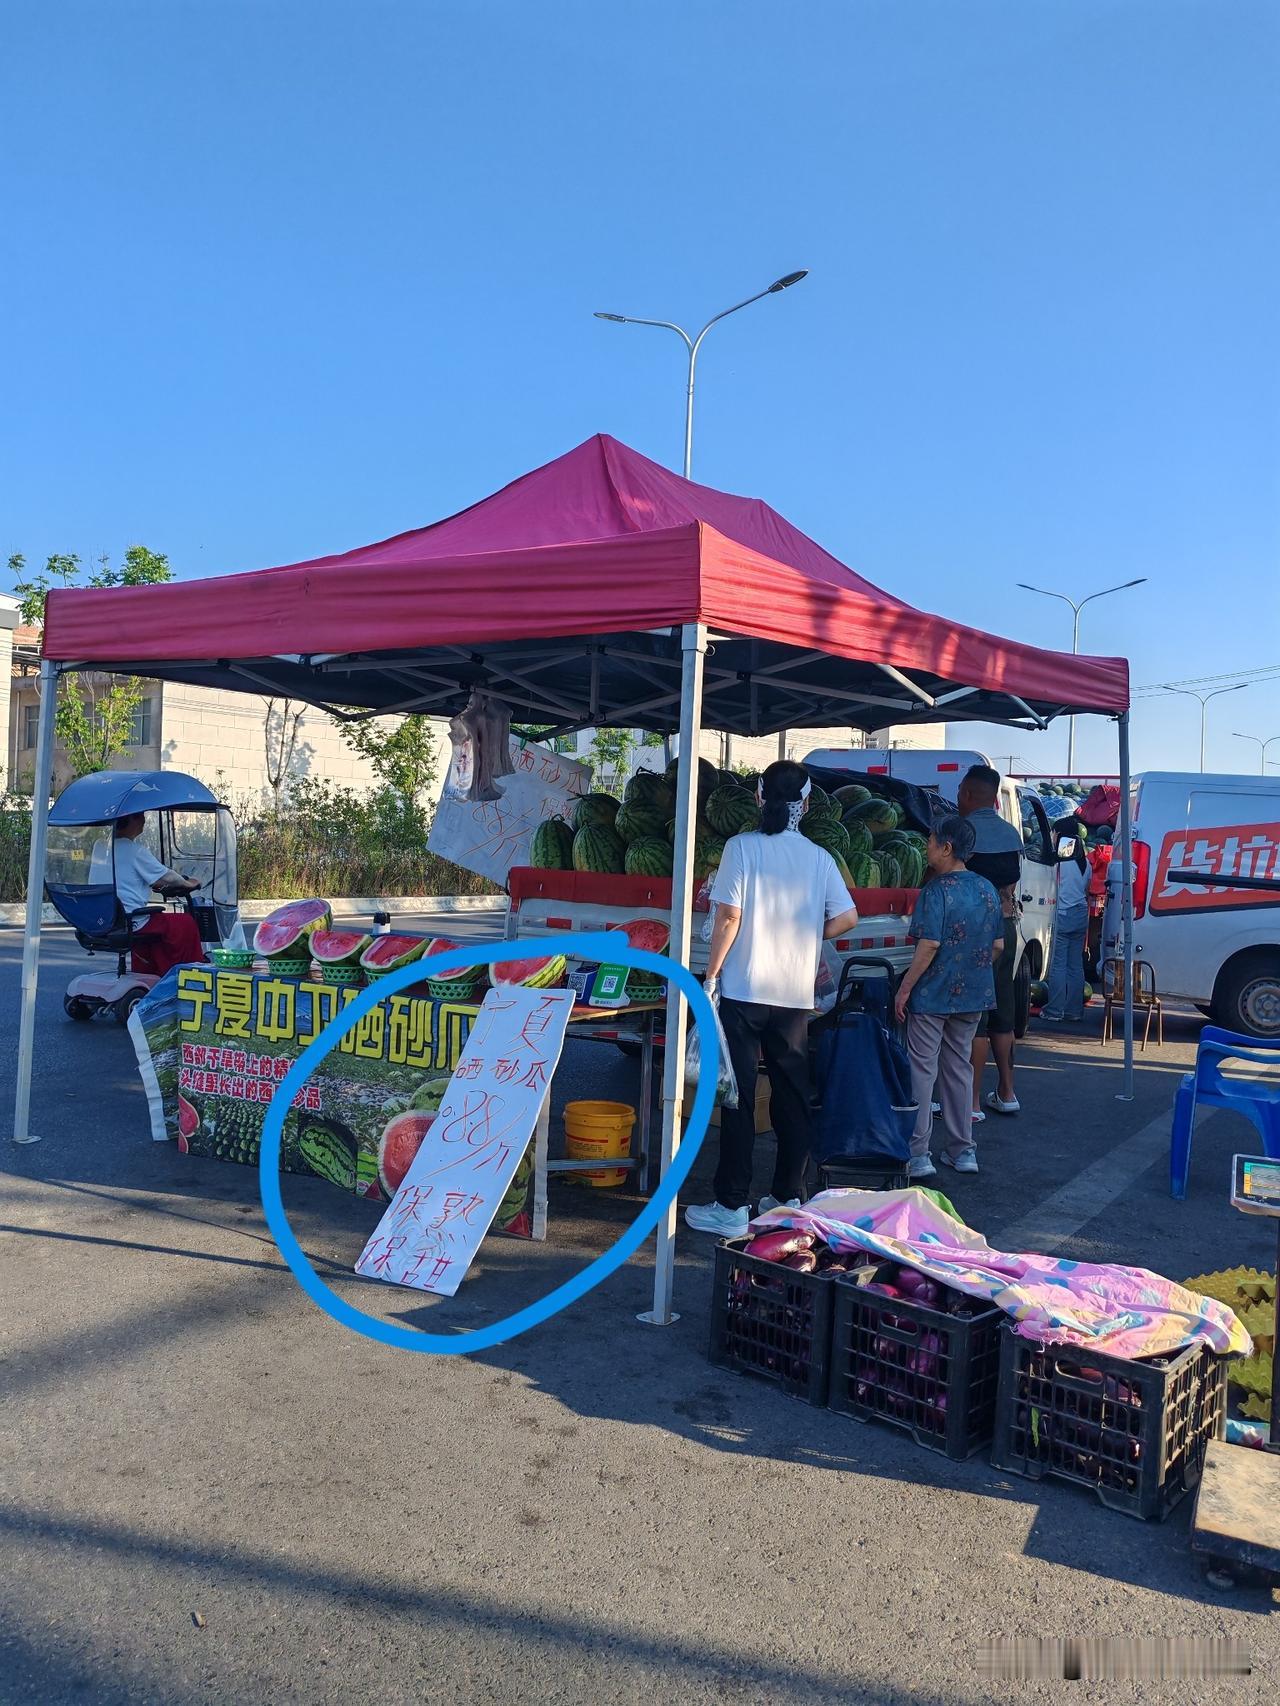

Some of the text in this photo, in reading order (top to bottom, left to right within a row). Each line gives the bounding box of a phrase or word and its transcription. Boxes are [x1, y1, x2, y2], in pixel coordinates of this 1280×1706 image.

[1158, 835, 1280, 897] 货拉
[483, 992, 565, 1056] 宁夏
[182, 1043, 297, 1080] 西部干旱带上的精
[387, 1184, 486, 1246] 保熟
[356, 1236, 454, 1289] 保甜
